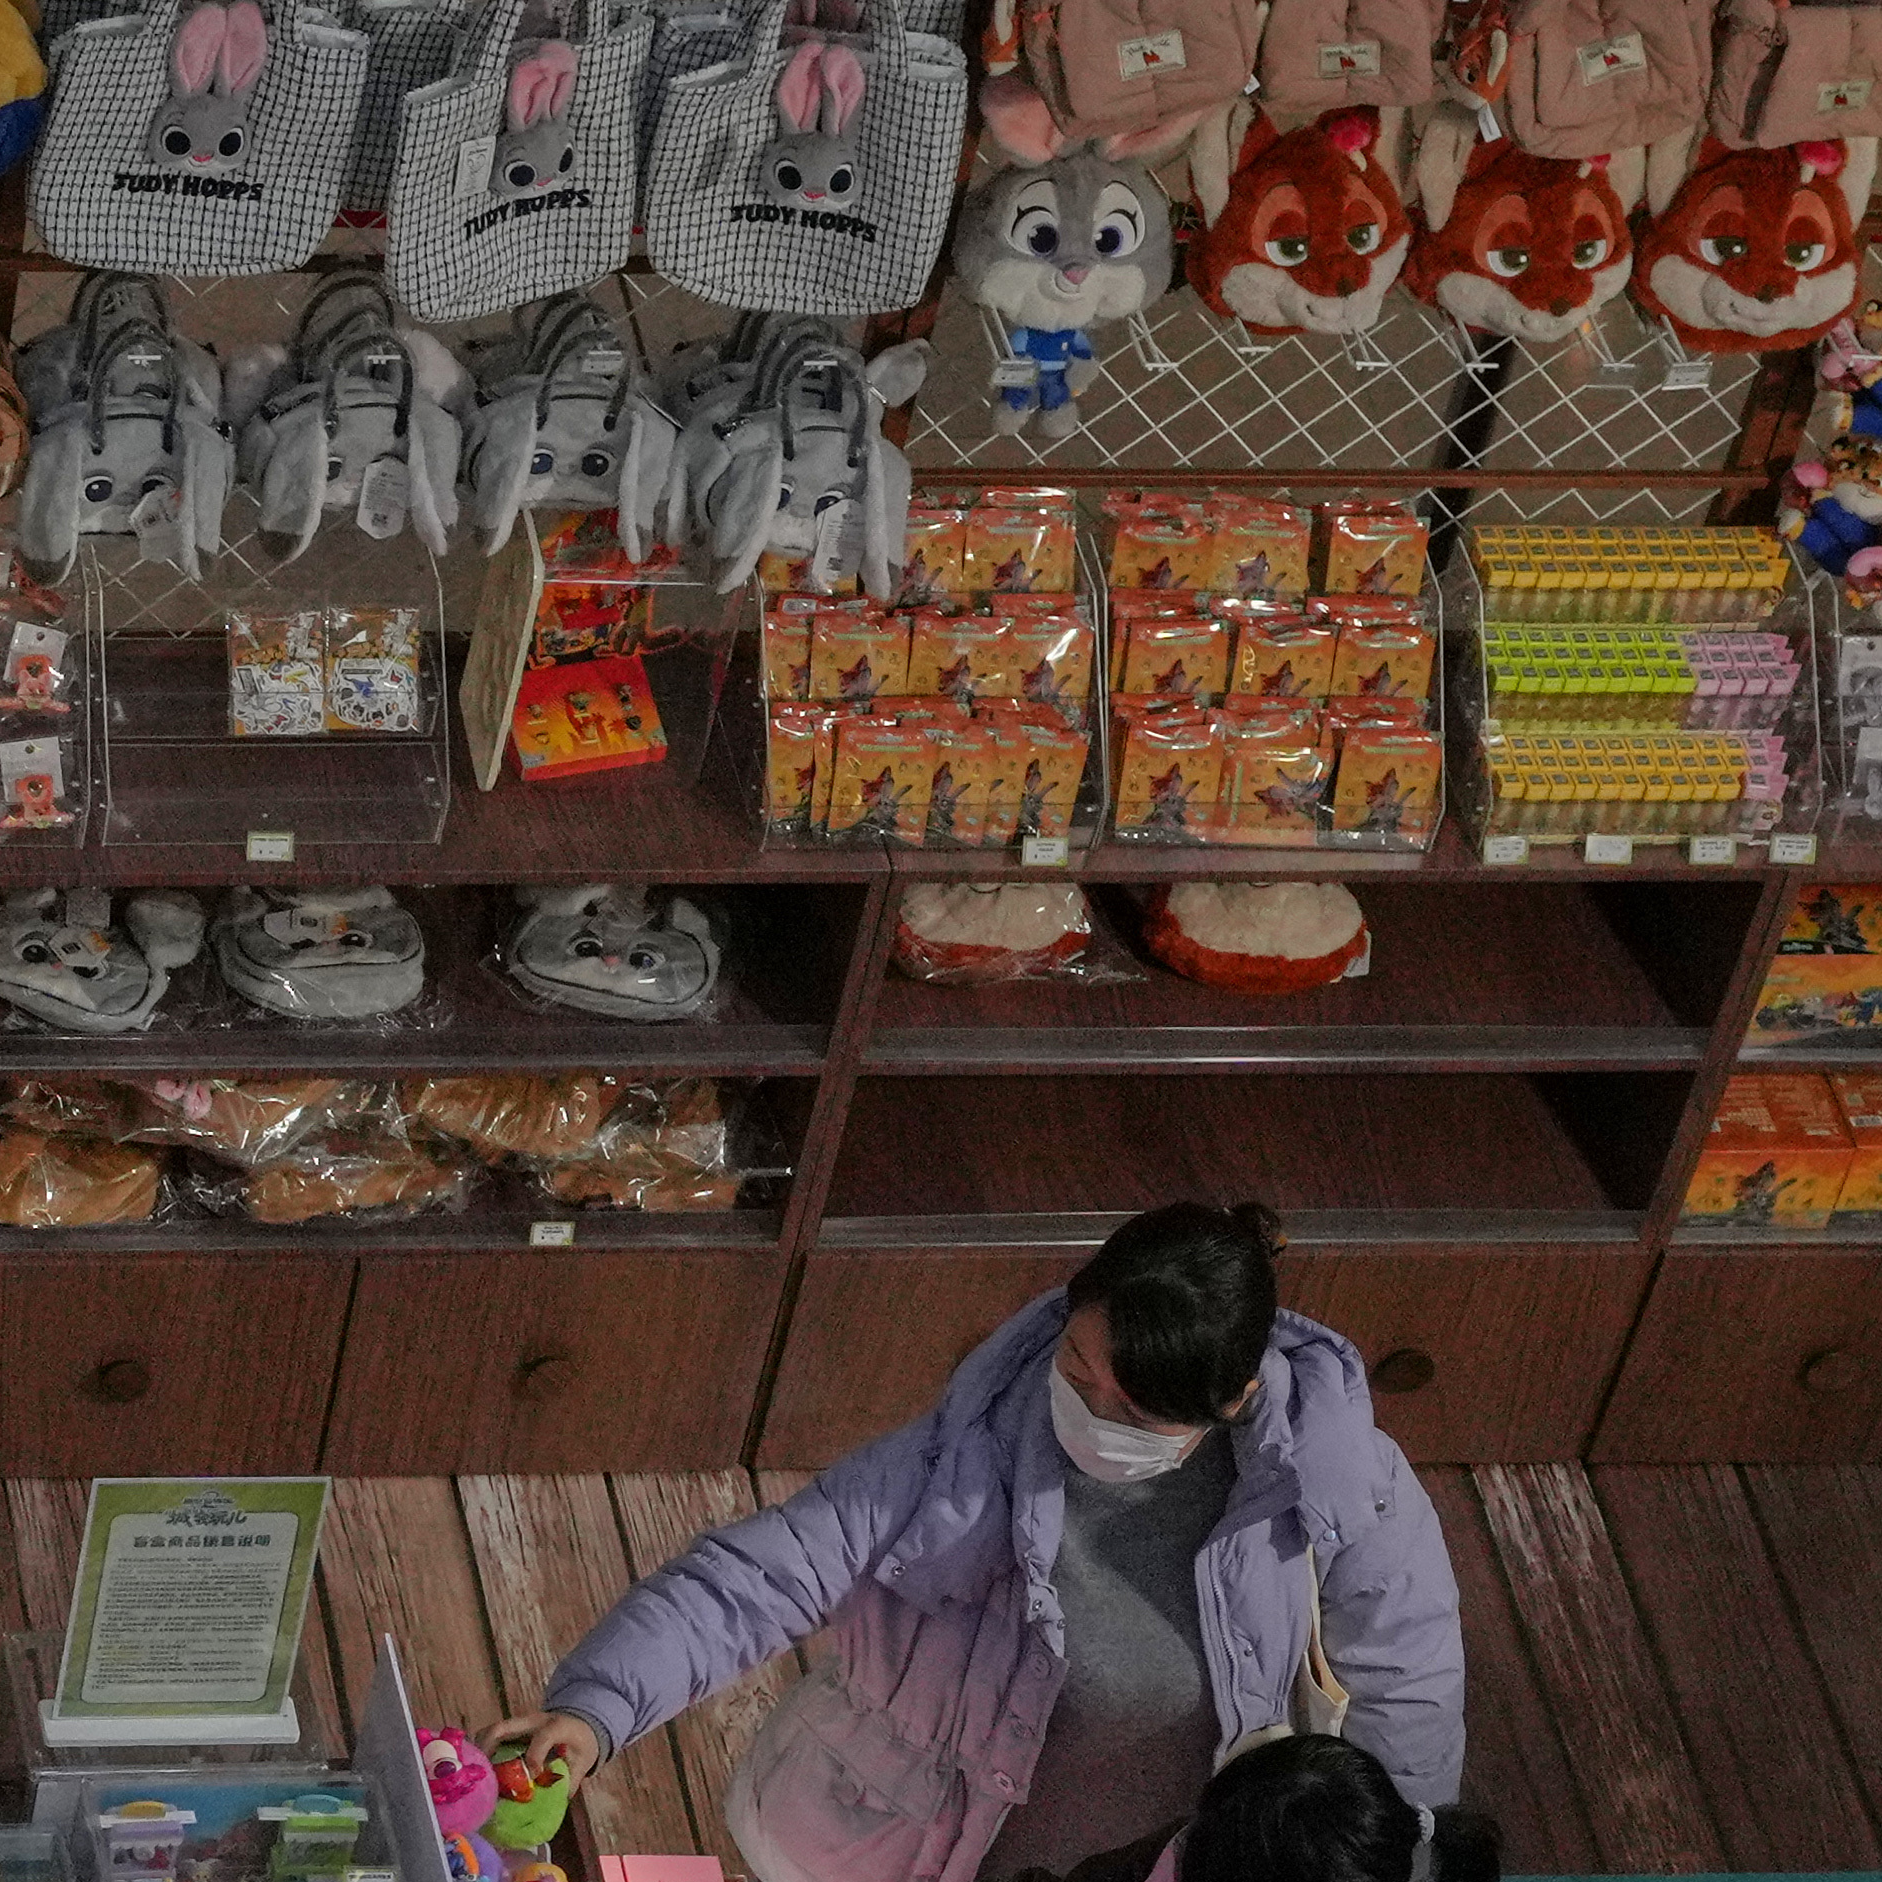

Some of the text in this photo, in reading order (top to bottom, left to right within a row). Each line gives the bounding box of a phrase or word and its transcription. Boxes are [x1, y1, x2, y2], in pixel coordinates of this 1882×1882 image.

[112, 173, 264, 201] JUDY HOPPS
[464, 189, 590, 240] JUDY HOPPS
[731, 204, 878, 243] JUDY HOPPS
